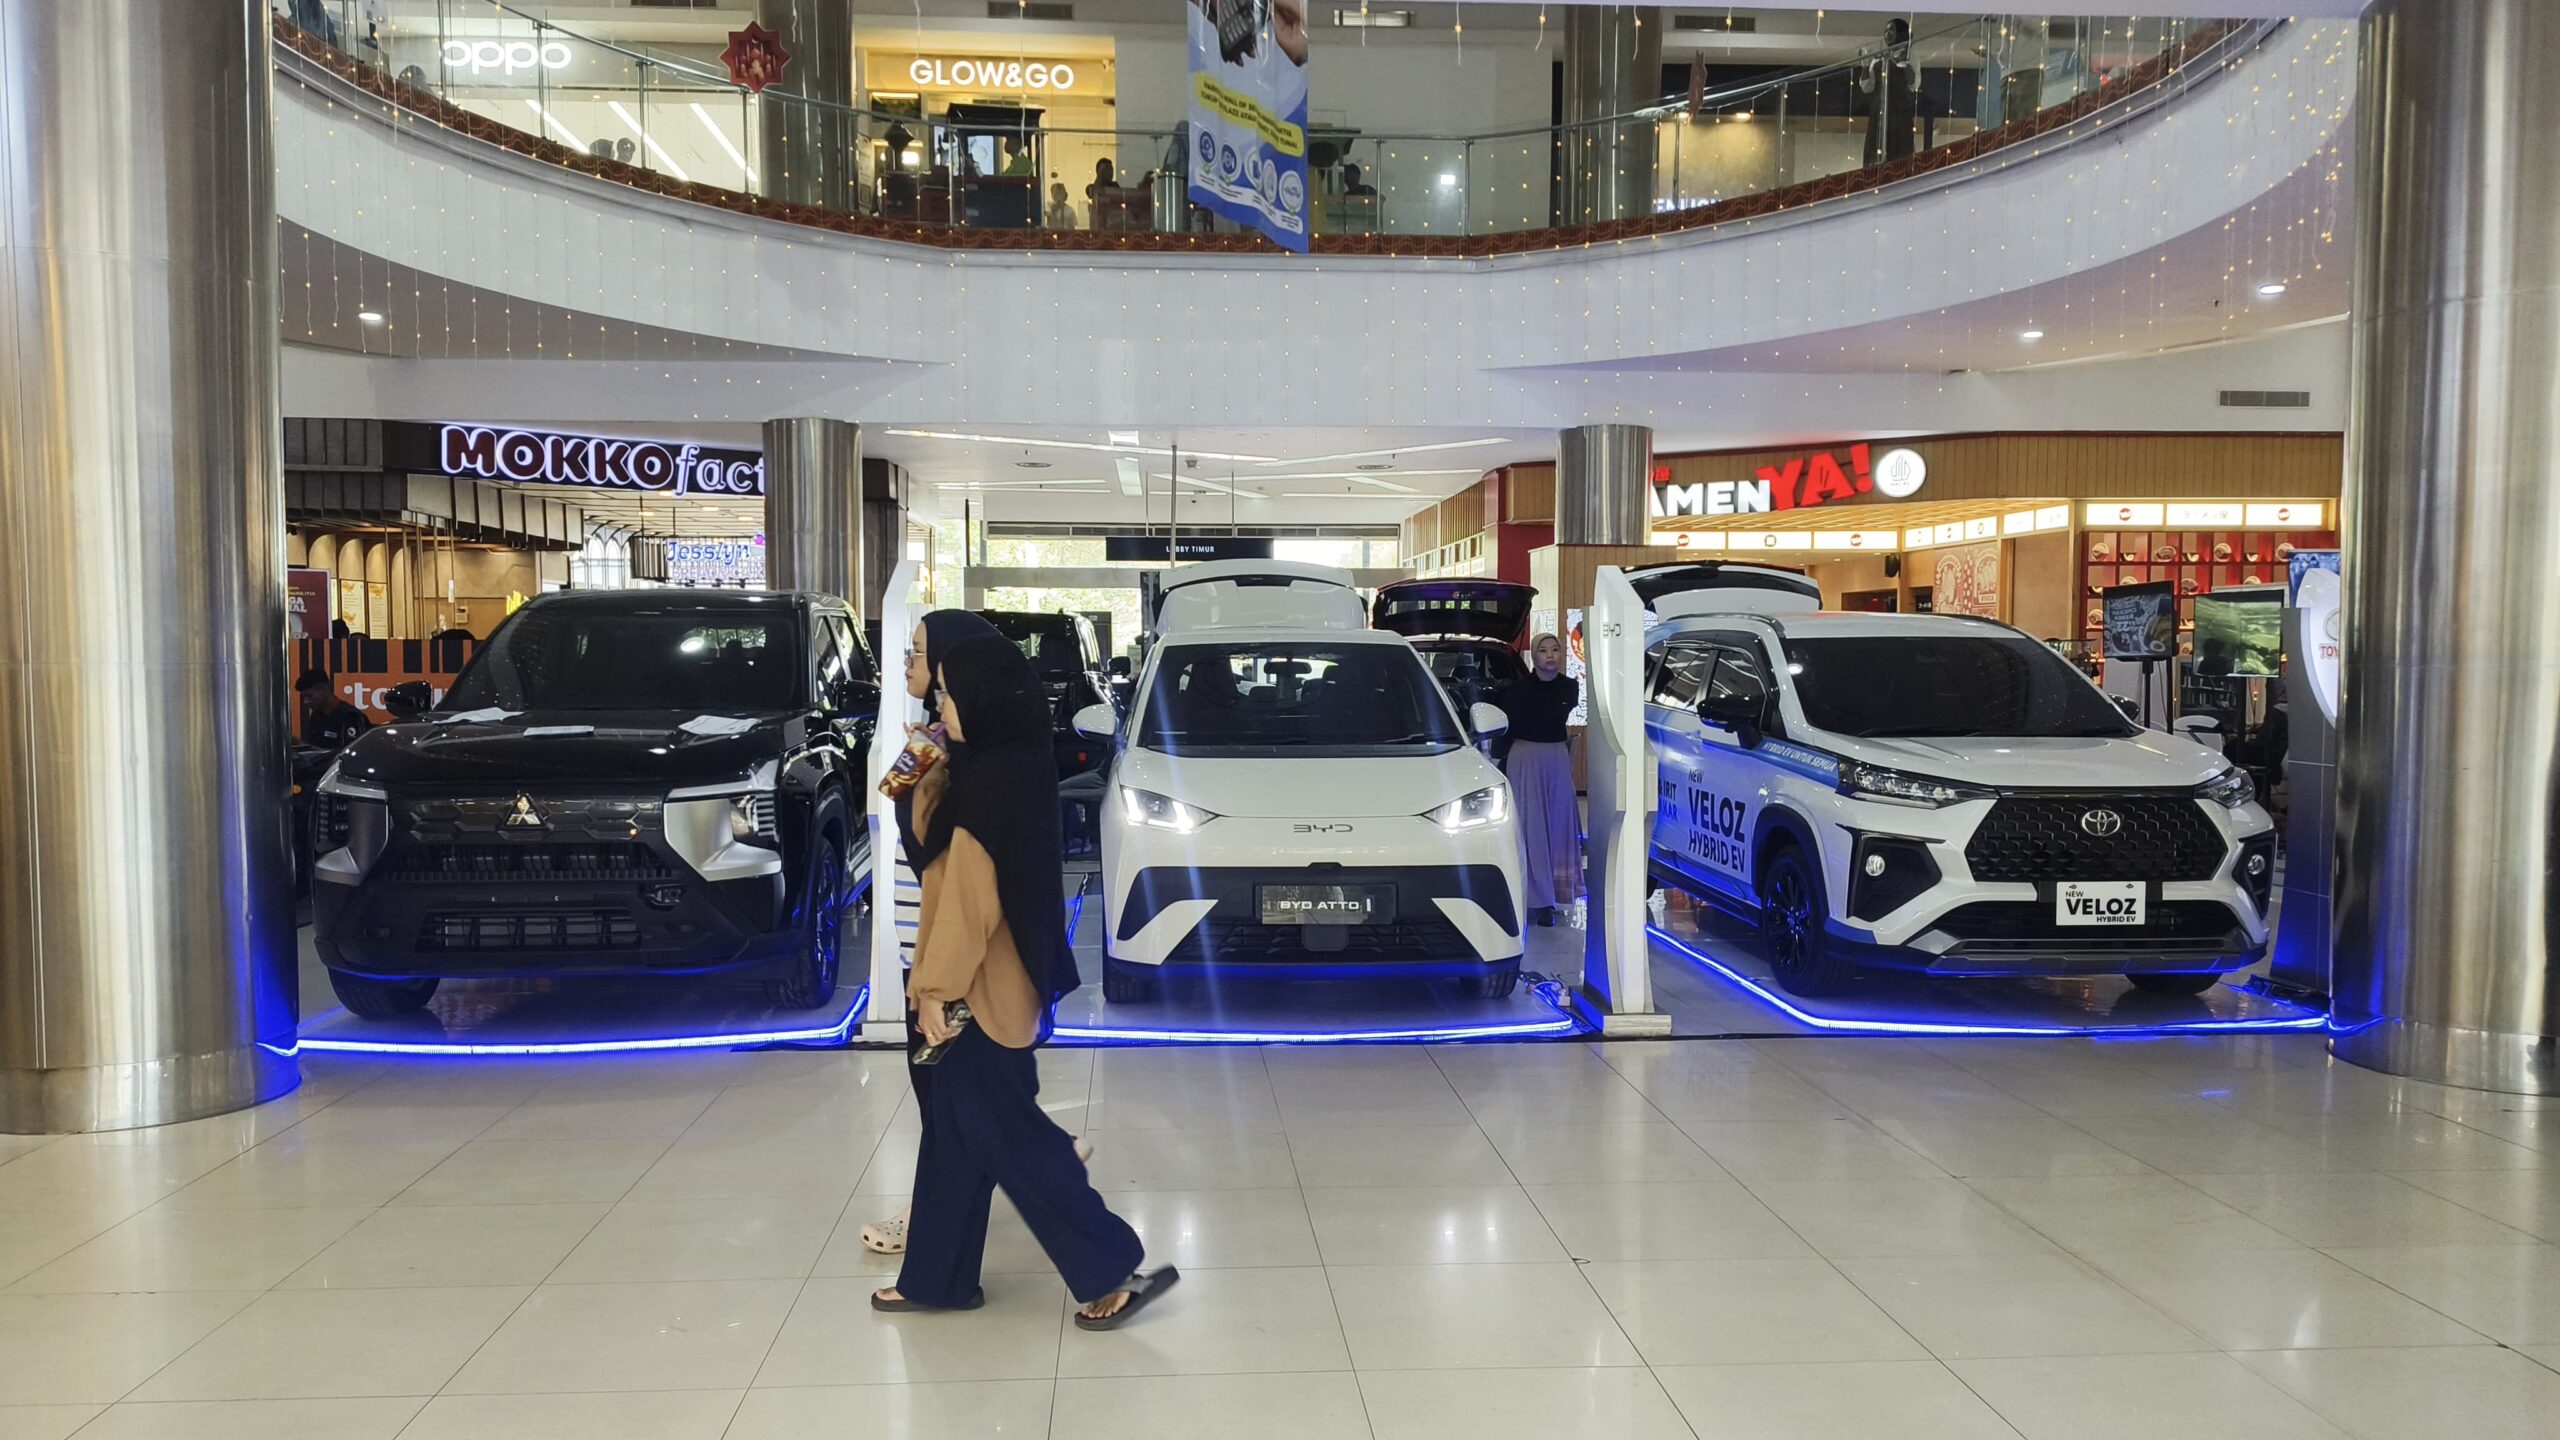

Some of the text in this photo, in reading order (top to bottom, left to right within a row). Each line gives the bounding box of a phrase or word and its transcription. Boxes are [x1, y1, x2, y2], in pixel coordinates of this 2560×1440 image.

[440, 41, 572, 75] oppo
[910, 60, 1074, 89] GLOW&GO
[441, 427, 675, 489] MOKKO
[667, 542, 750, 566] Jesslyn
[1602, 623, 1621, 637] BYD
[1688, 768, 1704, 784] NEW
[1663, 780, 1677, 800] IRIT
[1688, 787, 1746, 843] VELOZ
[1293, 824, 1354, 833] BYD
[1688, 829, 1745, 873] HYBRID EV
[1280, 901, 1312, 910] BYD
[1317, 901, 1360, 910] ATTO
[2065, 898, 2137, 916] VELOZ
